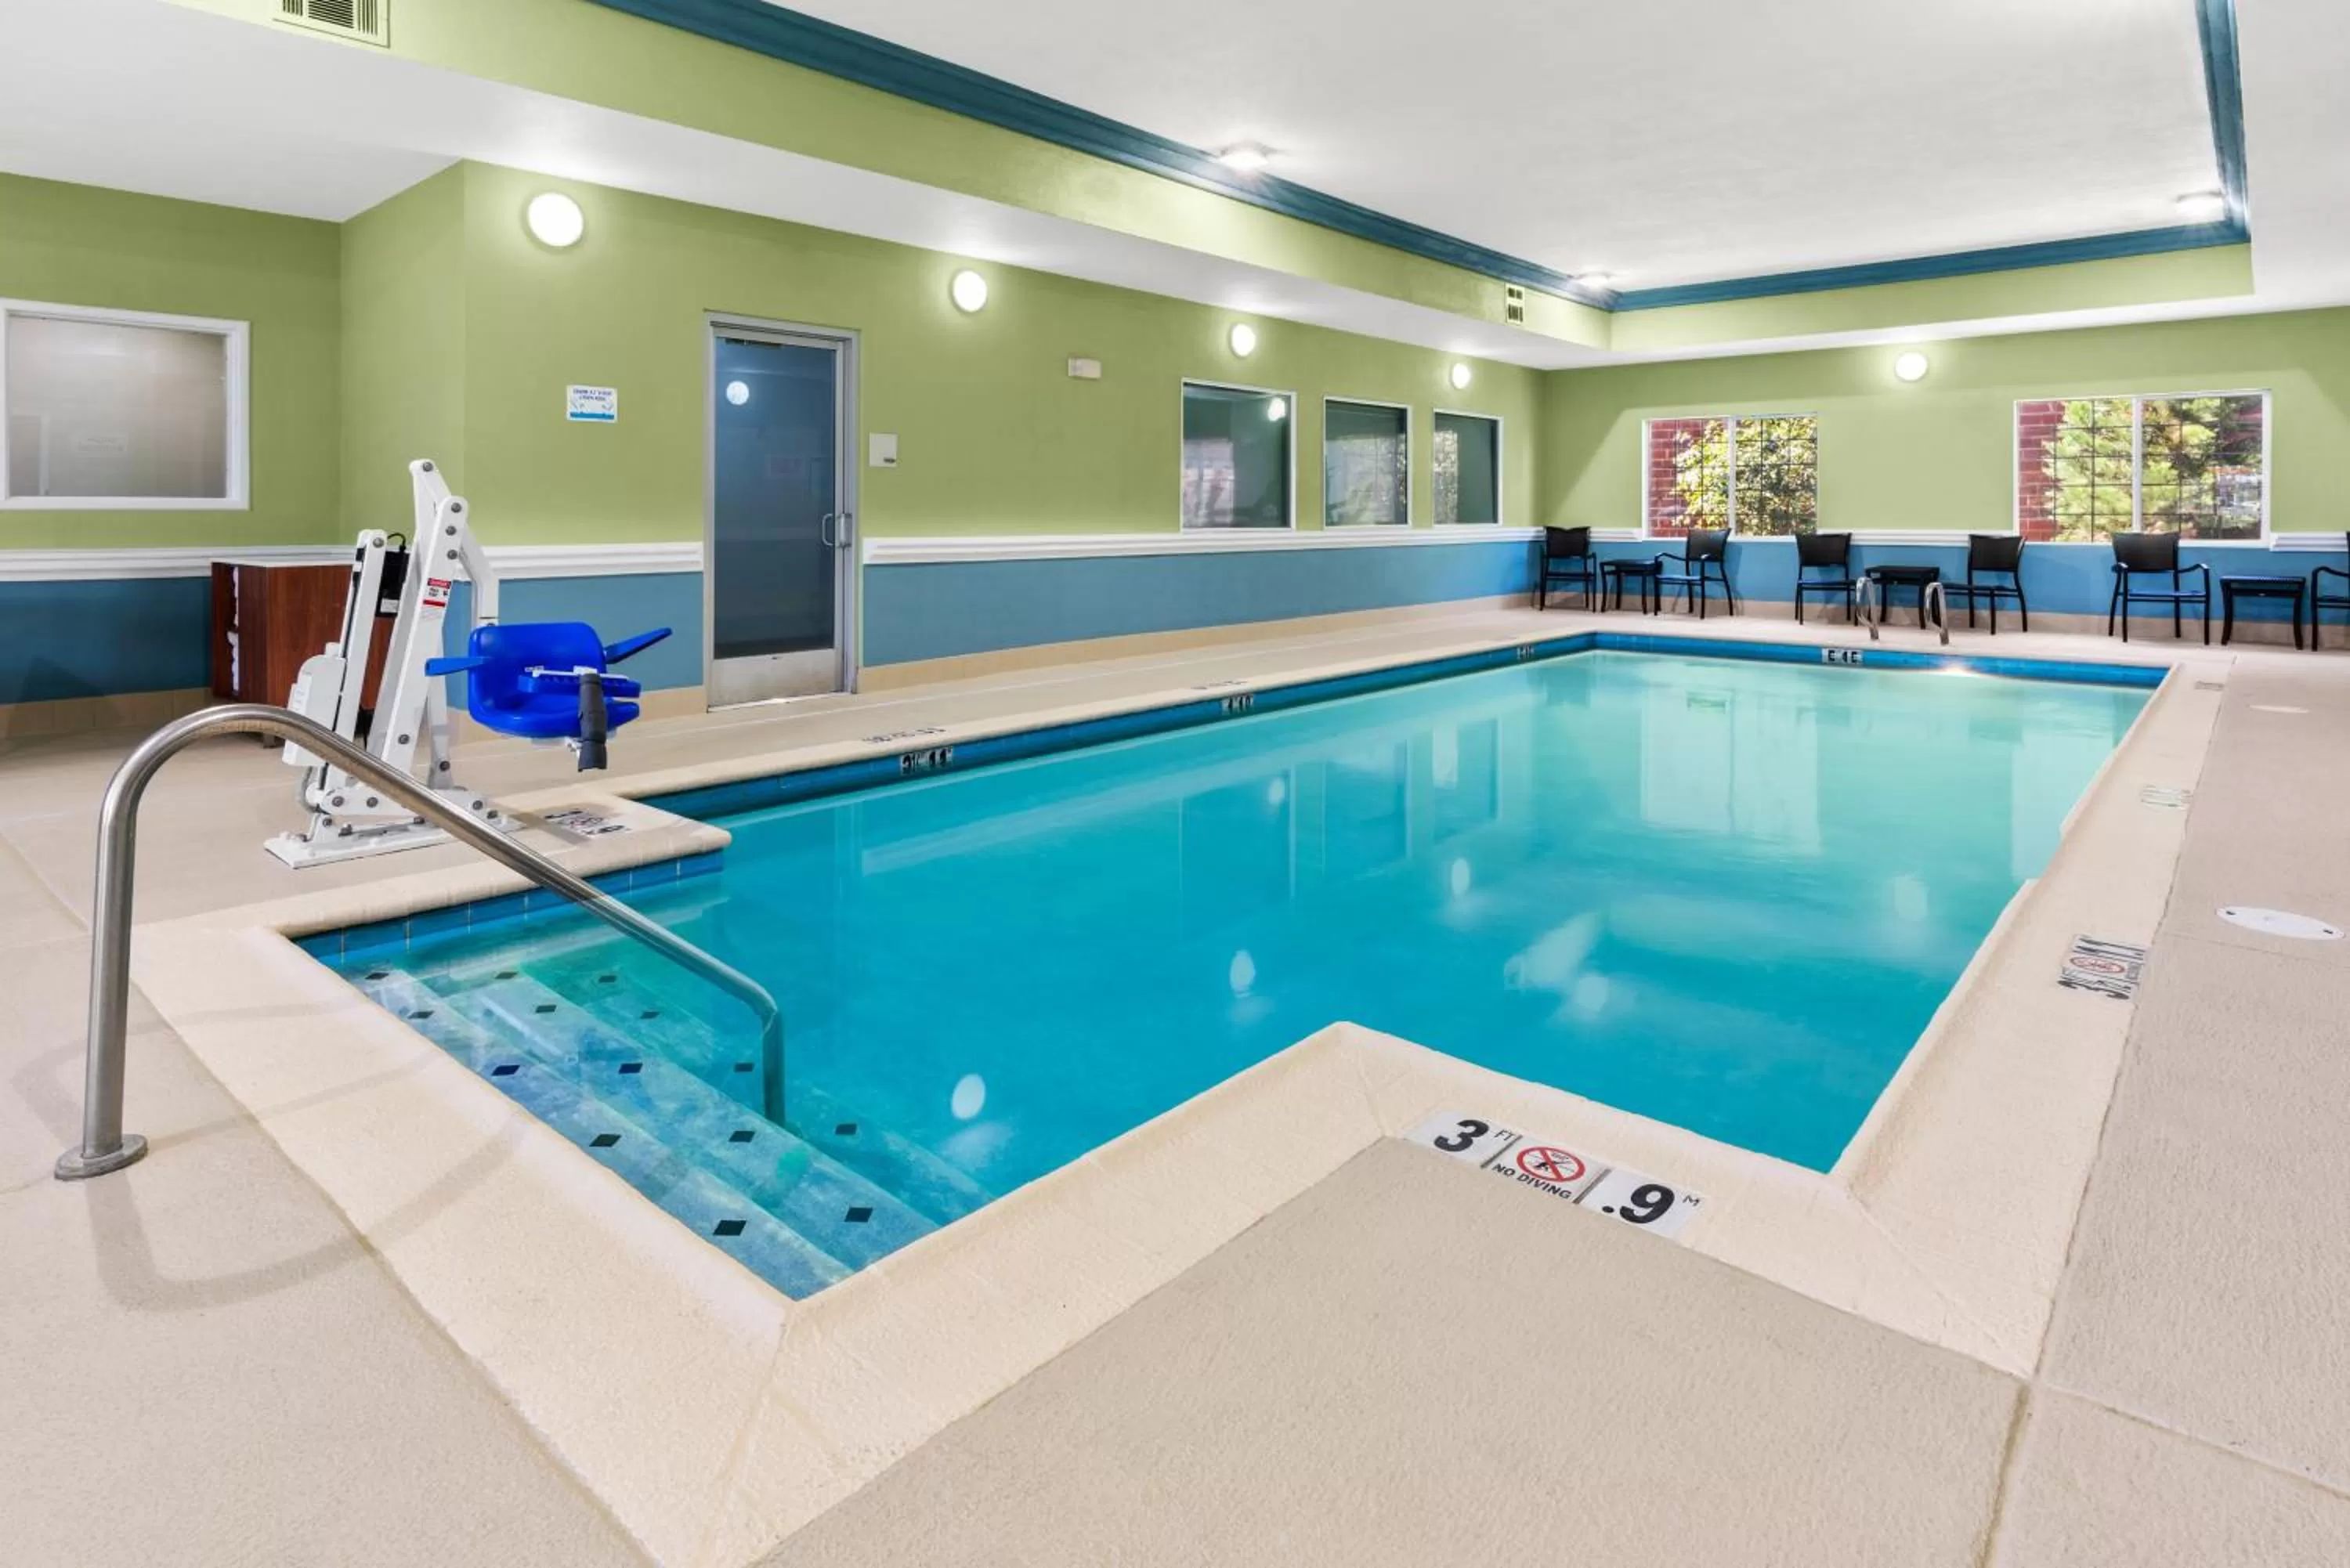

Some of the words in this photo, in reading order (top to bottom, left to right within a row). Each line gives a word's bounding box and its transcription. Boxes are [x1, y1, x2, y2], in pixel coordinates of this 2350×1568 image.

[1434, 1119, 1488, 1152] 3
[1494, 1129, 1516, 1141] FT
[1491, 1163, 1516, 1176] NO
[1517, 1172, 1571, 1199] DIVING
[1602, 1183, 1675, 1223] .9
[1682, 1194, 1700, 1206] M
